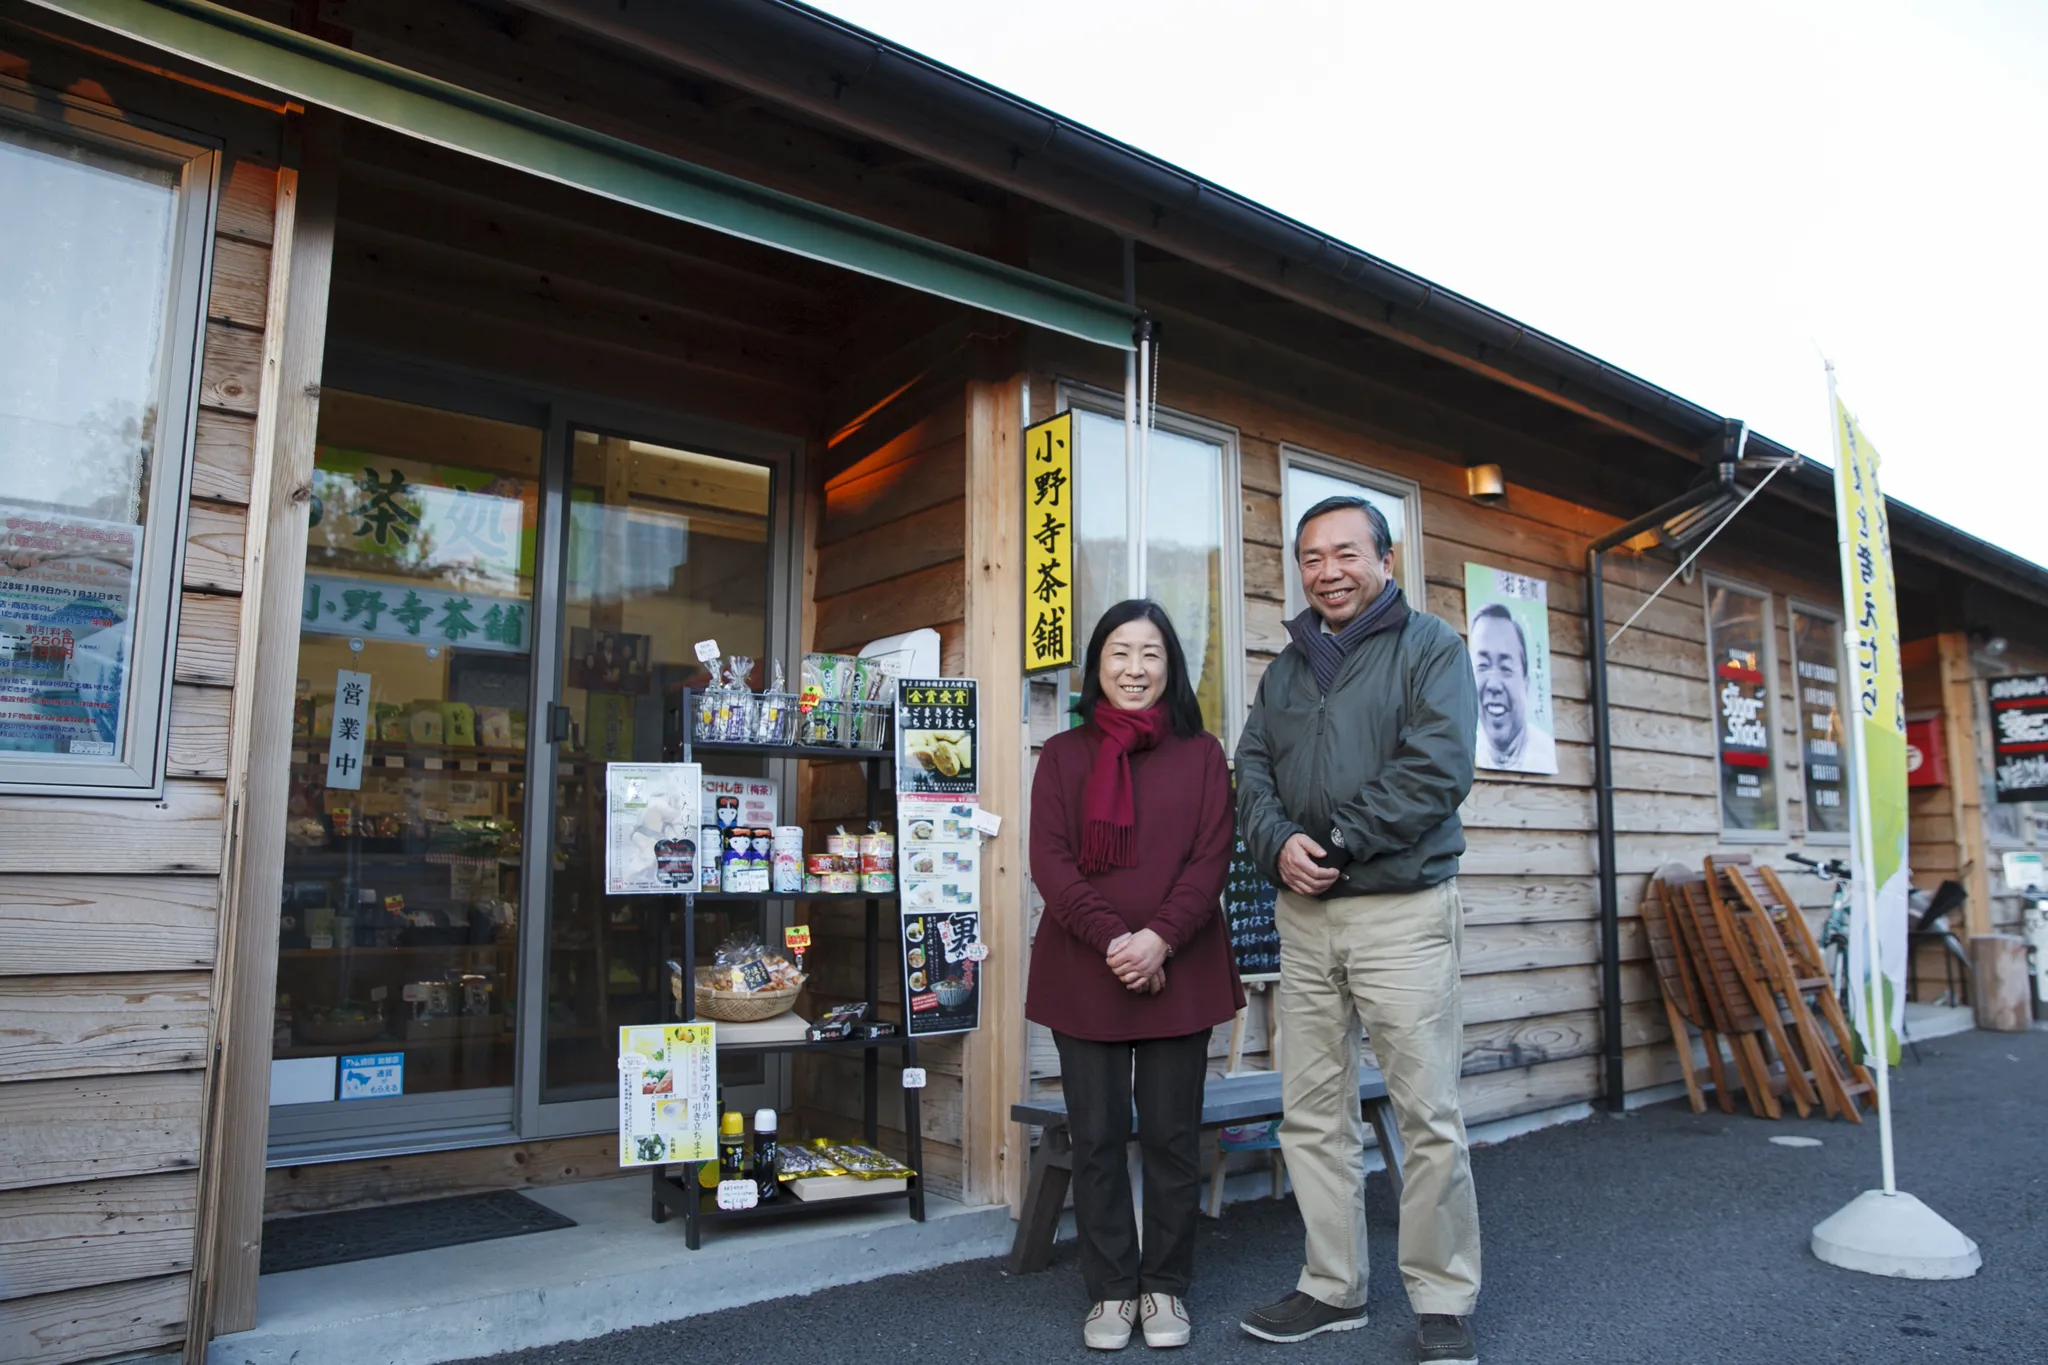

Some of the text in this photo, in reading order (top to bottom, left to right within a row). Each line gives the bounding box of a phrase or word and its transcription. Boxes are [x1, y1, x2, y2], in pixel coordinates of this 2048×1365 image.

[309, 466, 508, 558] 茶処
[1032, 430, 1068, 660] 小野寺茶舗
[25, 624, 73, 638] 割引料金
[31, 636, 75, 648] 250円
[303, 583, 525, 647] 小野寺茶舗
[908, 689, 967, 705] 金賞受賞
[912, 718, 976, 729] ちぎり草もち
[334, 681, 364, 777] 営業中
[700, 1027, 711, 1120] 国産天然ゆずの香りが
[692, 1102, 702, 1158] 引き立ちます
